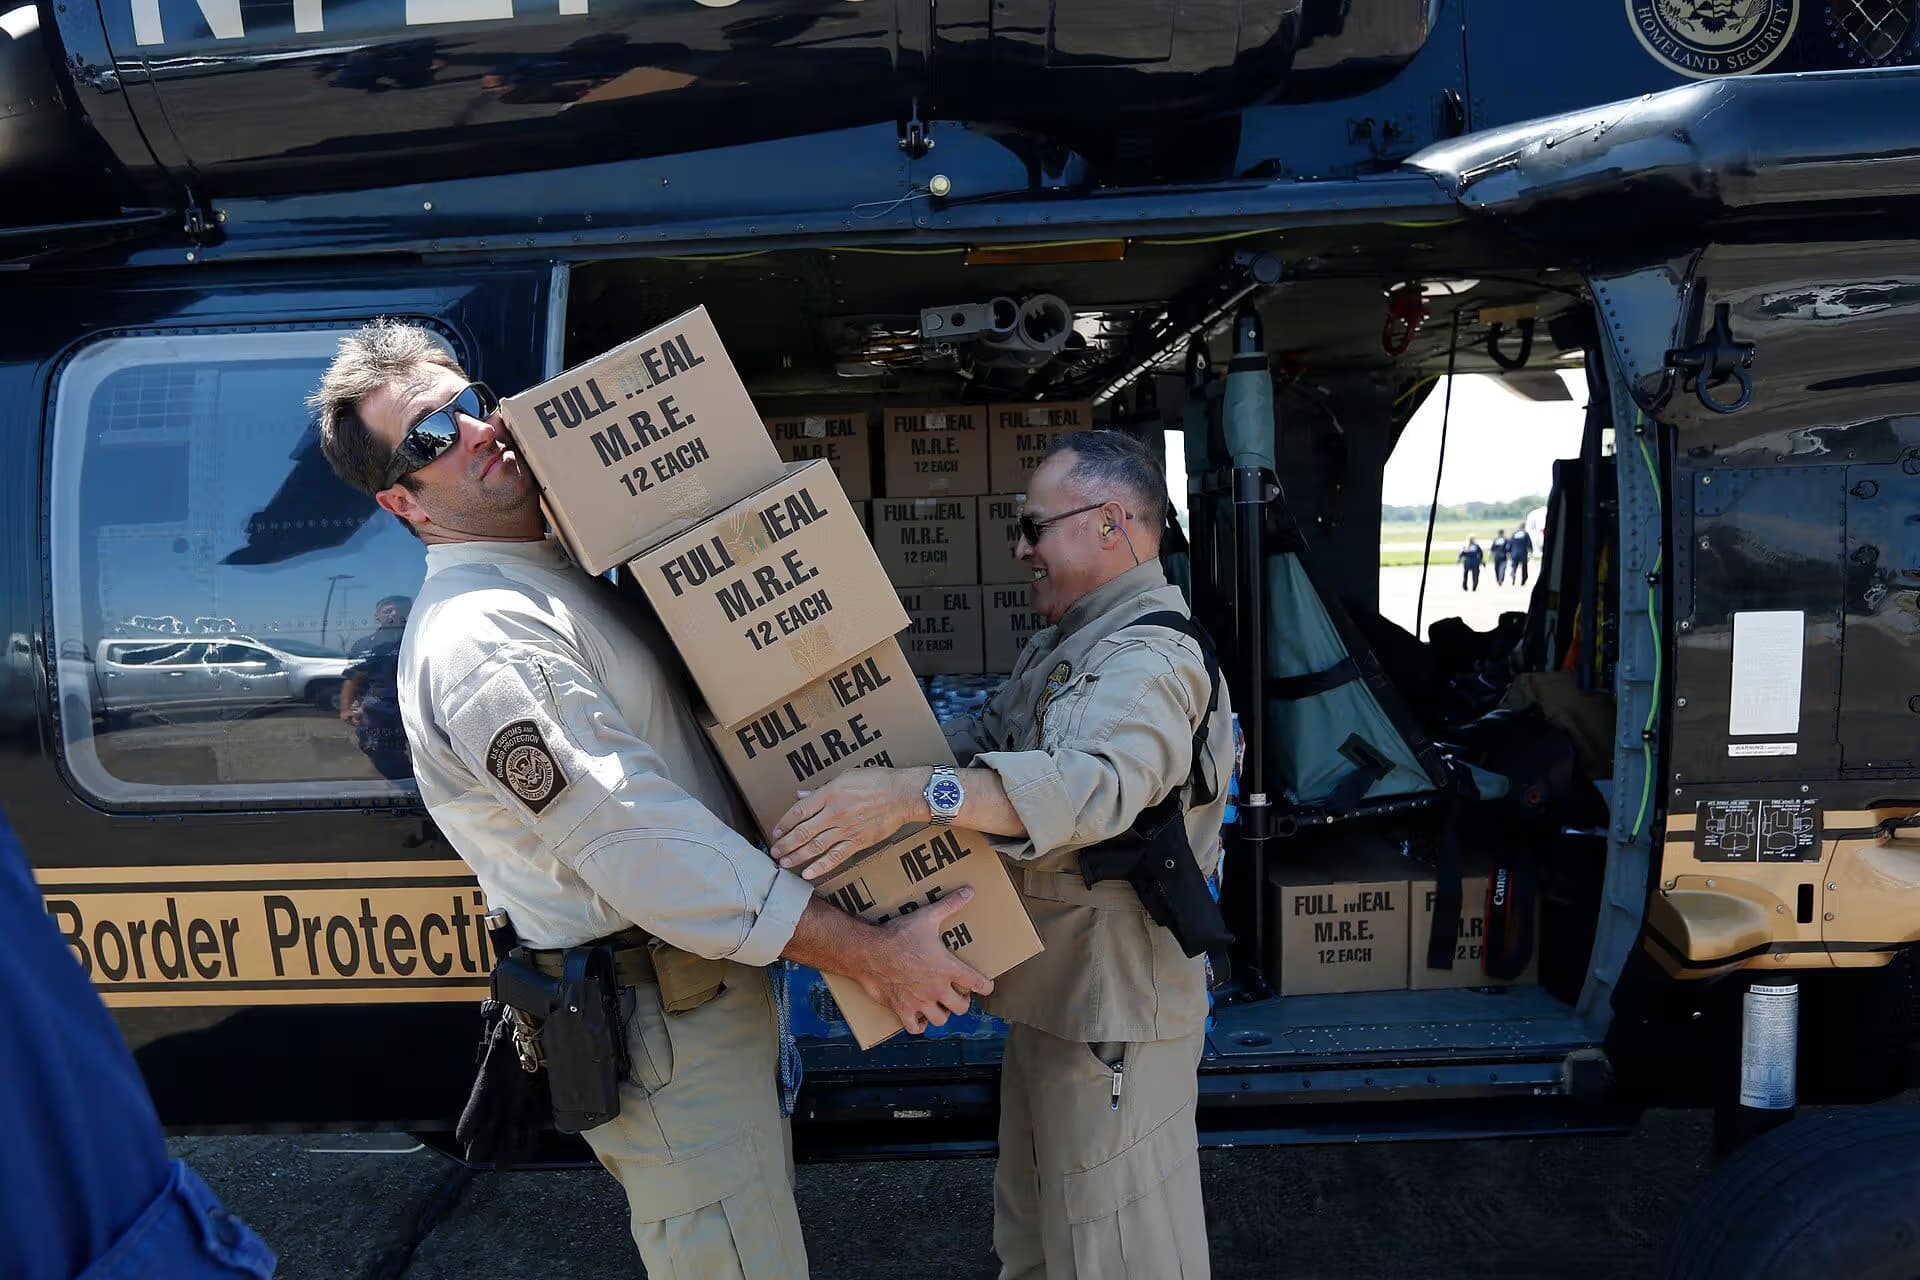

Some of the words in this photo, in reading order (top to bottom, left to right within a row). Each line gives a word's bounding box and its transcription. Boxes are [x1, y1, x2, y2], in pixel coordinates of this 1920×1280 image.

[1638, 7, 1720, 70] HOMELAND
[1727, 6, 1789, 69] SECURITY
[534, 378, 617, 439] FULL
[625, 334, 705, 399] EAL
[590, 395, 696, 468] M.R.E.
[825, 418, 856, 437] EAL
[942, 412, 976, 431] EAL
[911, 436, 960, 456] M.R.E.
[619, 466, 654, 497] 12
[650, 436, 710, 482] EACH
[913, 460, 930, 474] 12
[931, 460, 959, 473] EACH
[757, 488, 829, 544] EAL
[990, 503, 1016, 520] FUL
[901, 527, 949, 545] M.R.E.
[903, 551, 918, 564] 12
[920, 550, 948, 563] EACH
[715, 549, 819, 623] M.R.E.
[944, 593, 971, 611] EAL
[994, 590, 1029, 608] FULL
[744, 620, 778, 651] 12
[775, 589, 833, 636] EACH
[736, 702, 807, 760] FULL
[828, 657, 892, 708] EAL
[496, 726, 522, 748] CUSTOMS
[503, 734, 540, 752] PROTECTION
[785, 713, 883, 783] M.R.E.
[1494, 868, 1507, 906] Canon
[1295, 893, 1337, 916] FULL
[46, 897, 240, 982] Border
[264, 891, 490, 977] Protecti
[941, 922, 973, 951] CH
[1314, 920, 1374, 943] M.R.E.
[1318, 949, 1336, 964] 12
[1338, 948, 1372, 963] EACH
